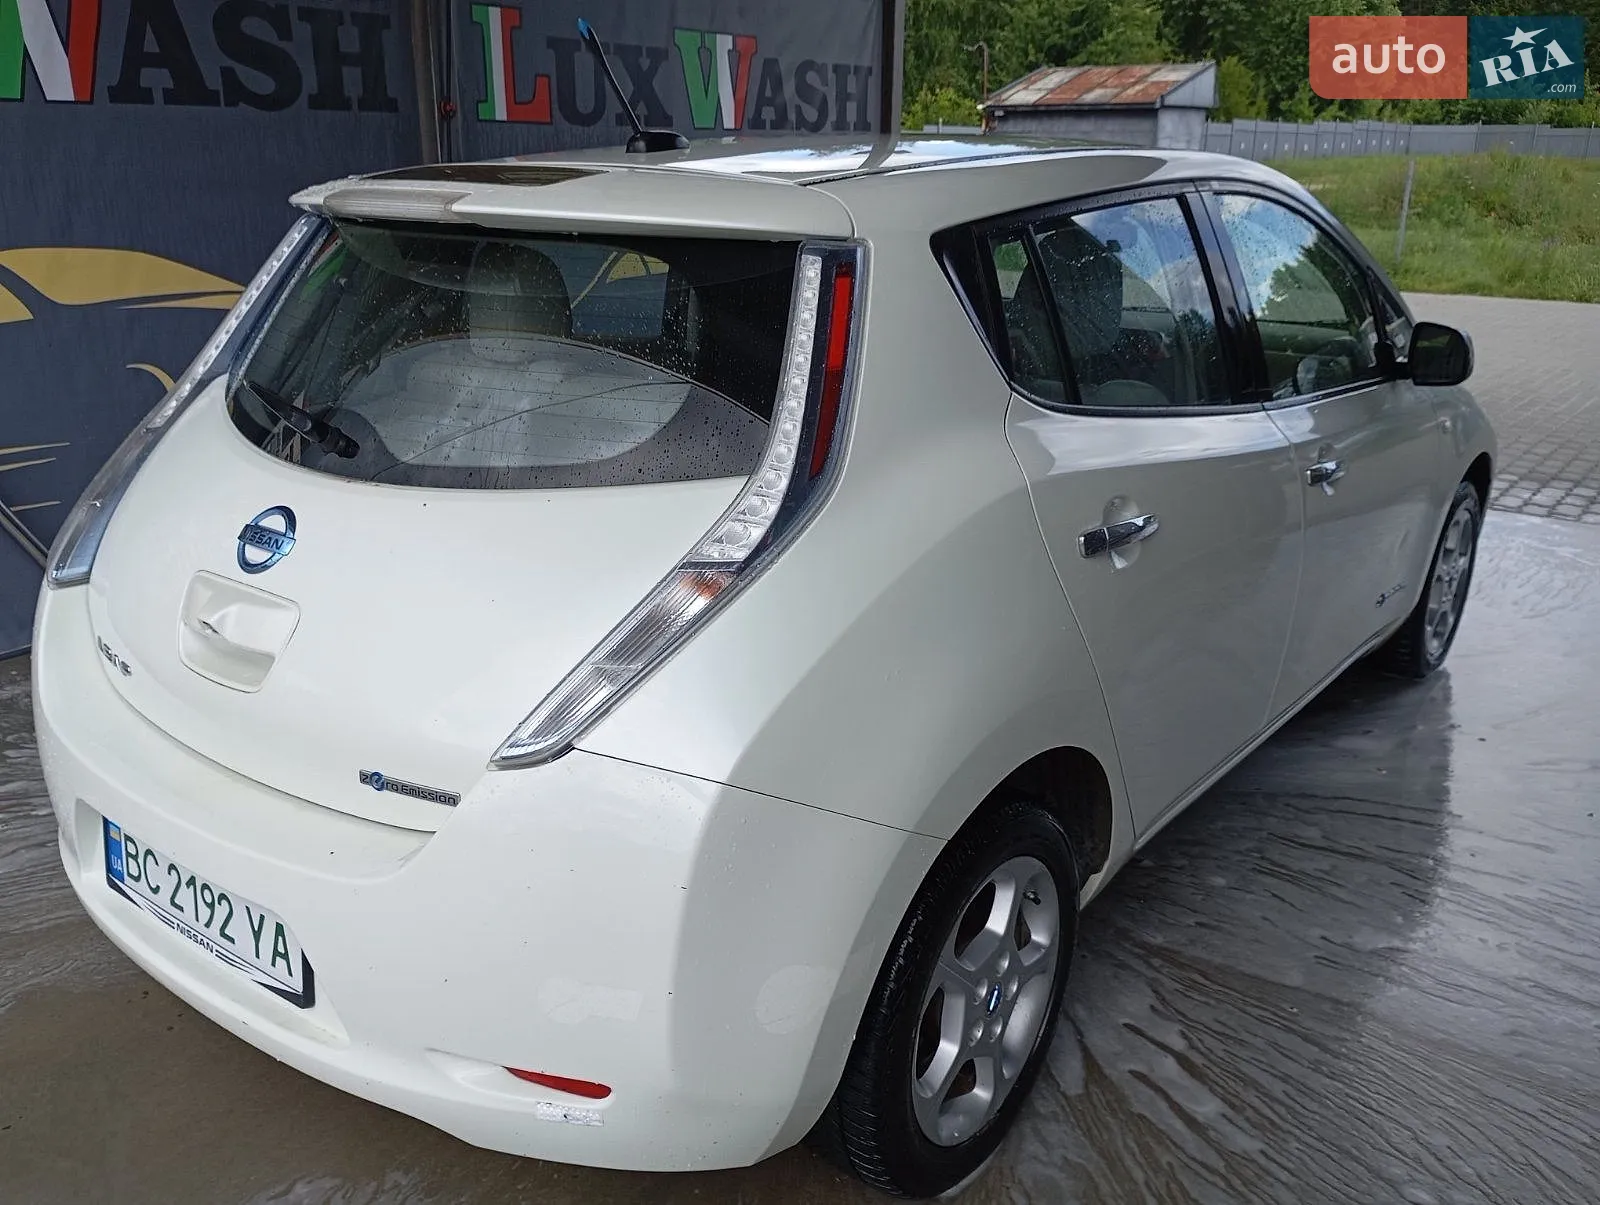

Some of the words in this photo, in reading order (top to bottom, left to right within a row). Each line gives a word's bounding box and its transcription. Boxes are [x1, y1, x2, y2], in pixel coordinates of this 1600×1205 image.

[471, 4, 674, 127] LUX
[673, 26, 873, 133] WASH
[242, 526, 285, 550] NISSAN
[110, 855, 123, 874] UA
[123, 832, 161, 895] BC
[167, 862, 236, 945] 2192
[245, 904, 294, 978] YA
[175, 922, 214, 954] NISSAN
